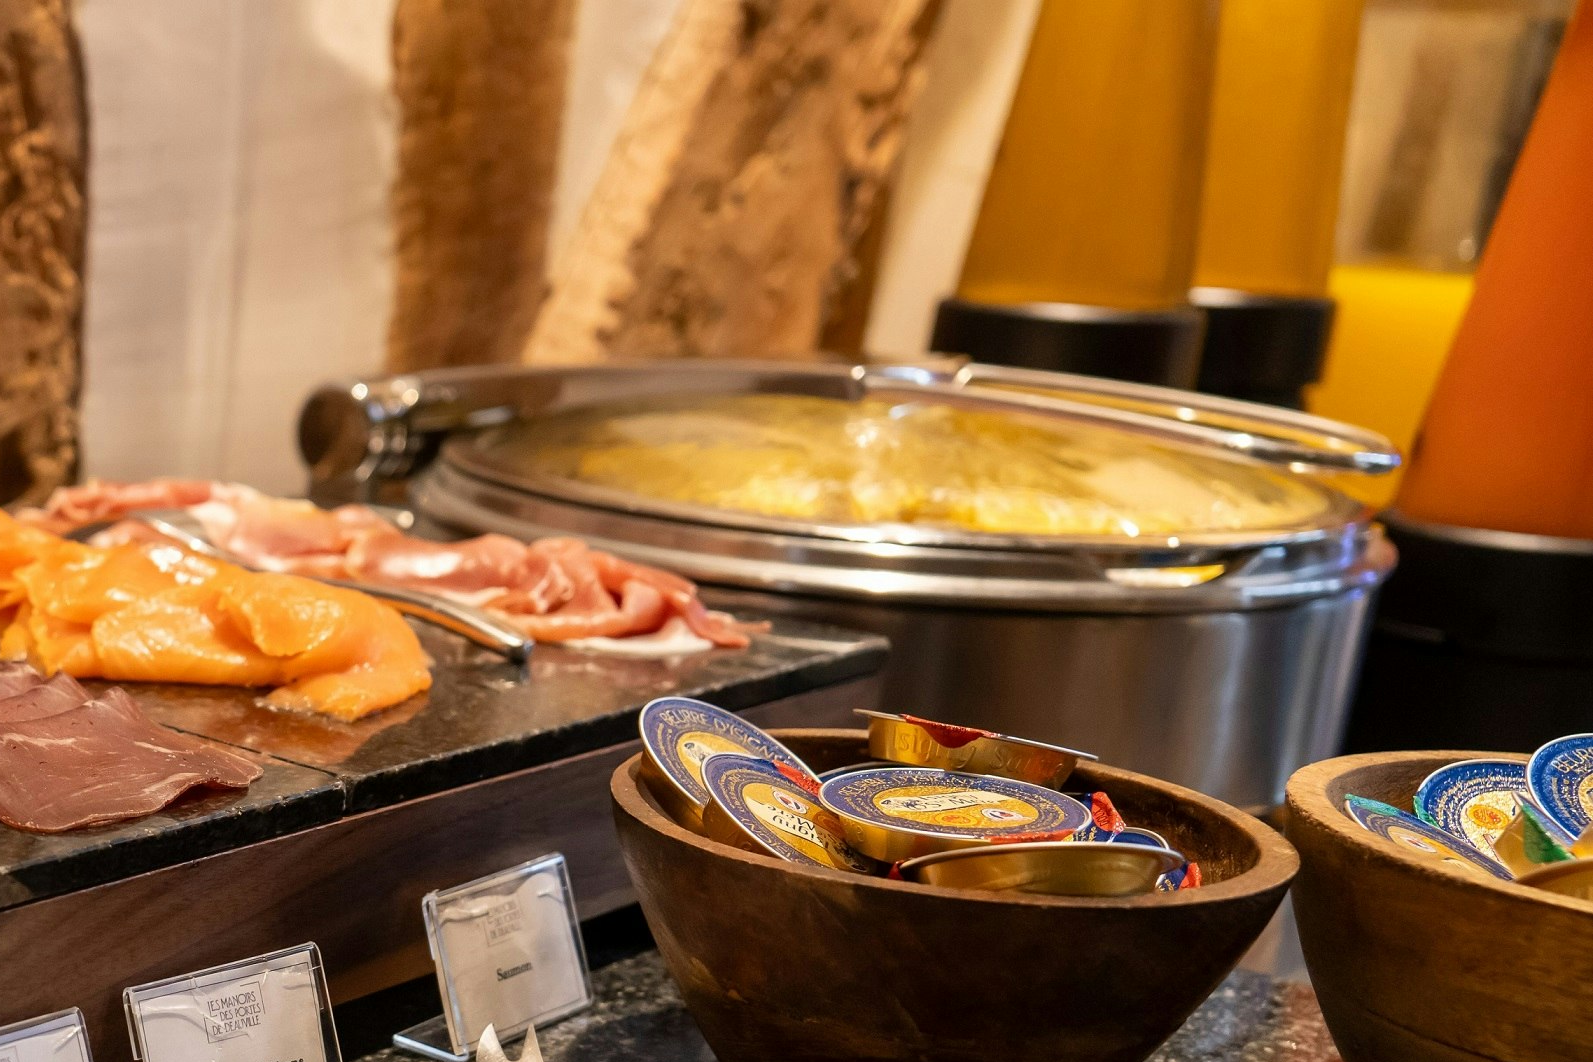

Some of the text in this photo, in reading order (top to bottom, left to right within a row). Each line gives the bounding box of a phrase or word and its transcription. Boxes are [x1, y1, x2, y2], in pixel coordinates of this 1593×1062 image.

[659, 709, 708, 727] BEURRE
[1551, 747, 1593, 773] BEUR
[207, 991, 256, 1017] LES MANOIRS
[219, 1003, 261, 1021] DES PORTES
[224, 1016, 261, 1032] DEAUVILLE
